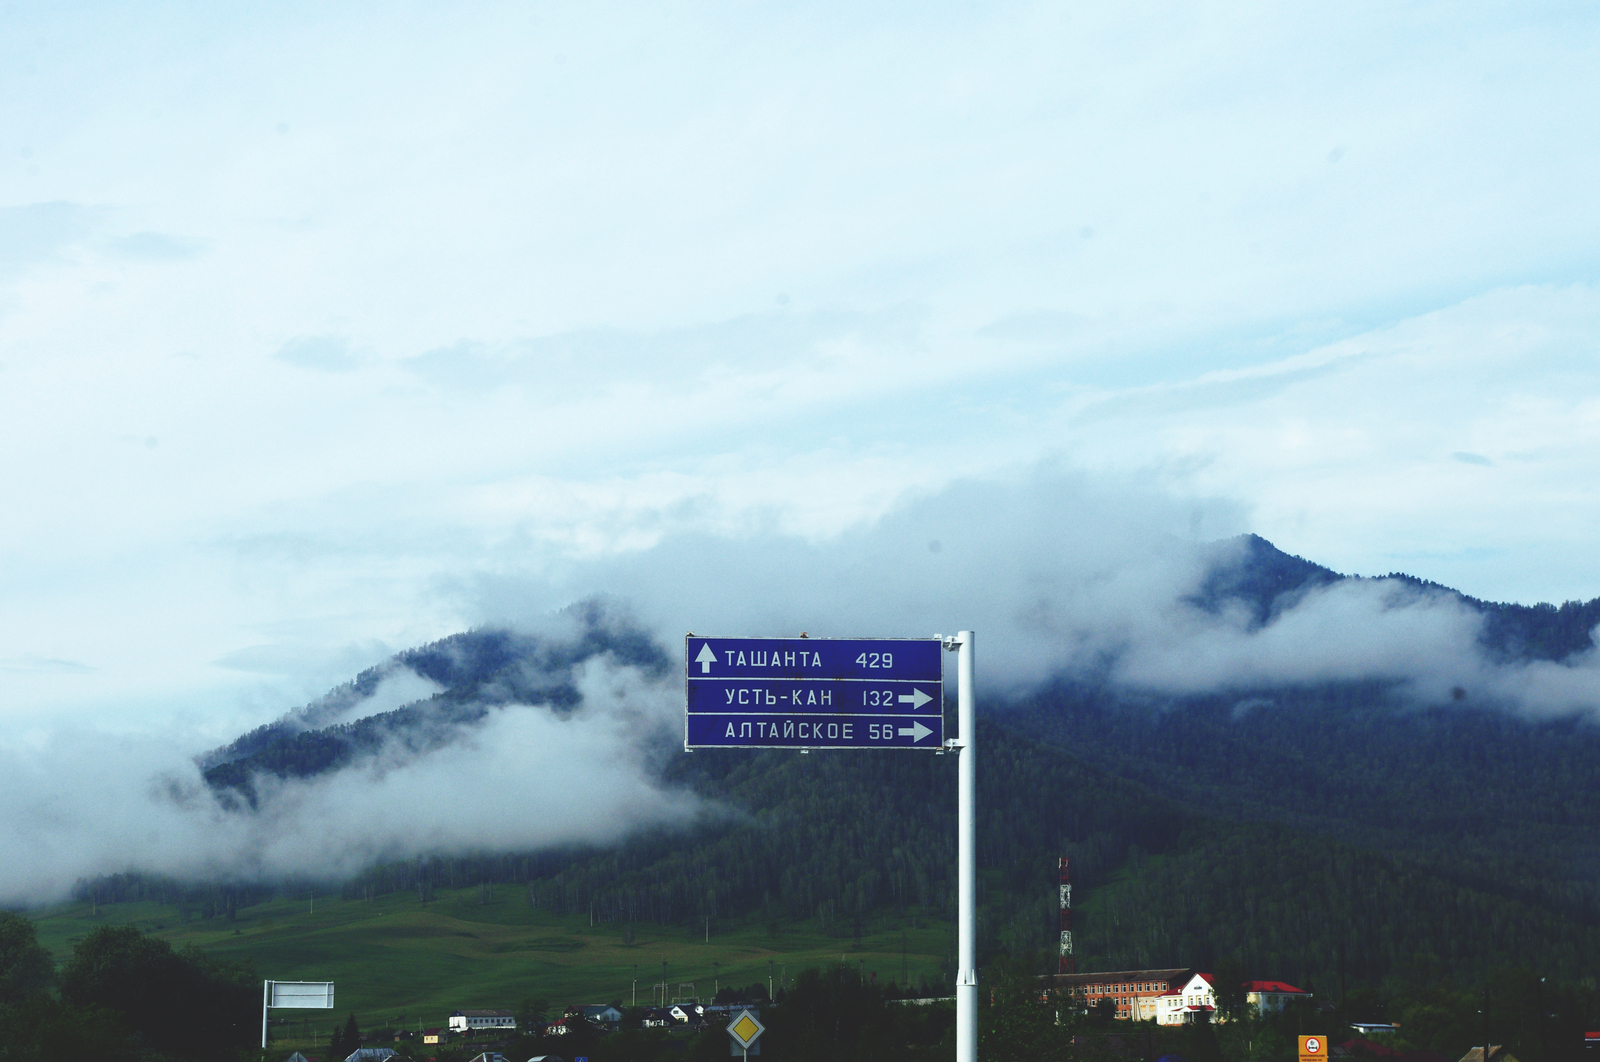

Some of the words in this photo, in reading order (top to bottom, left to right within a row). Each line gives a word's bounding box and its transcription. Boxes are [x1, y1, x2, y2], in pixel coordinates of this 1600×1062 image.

[724, 650, 822, 667] ТАШАНТА
[855, 652, 893, 669] 429
[725, 688, 832, 706] УСТЬ-КАН
[863, 690, 893, 707] 132
[725, 720, 854, 739] АЛТАЙСКОЕ
[869, 723, 893, 740] 56
